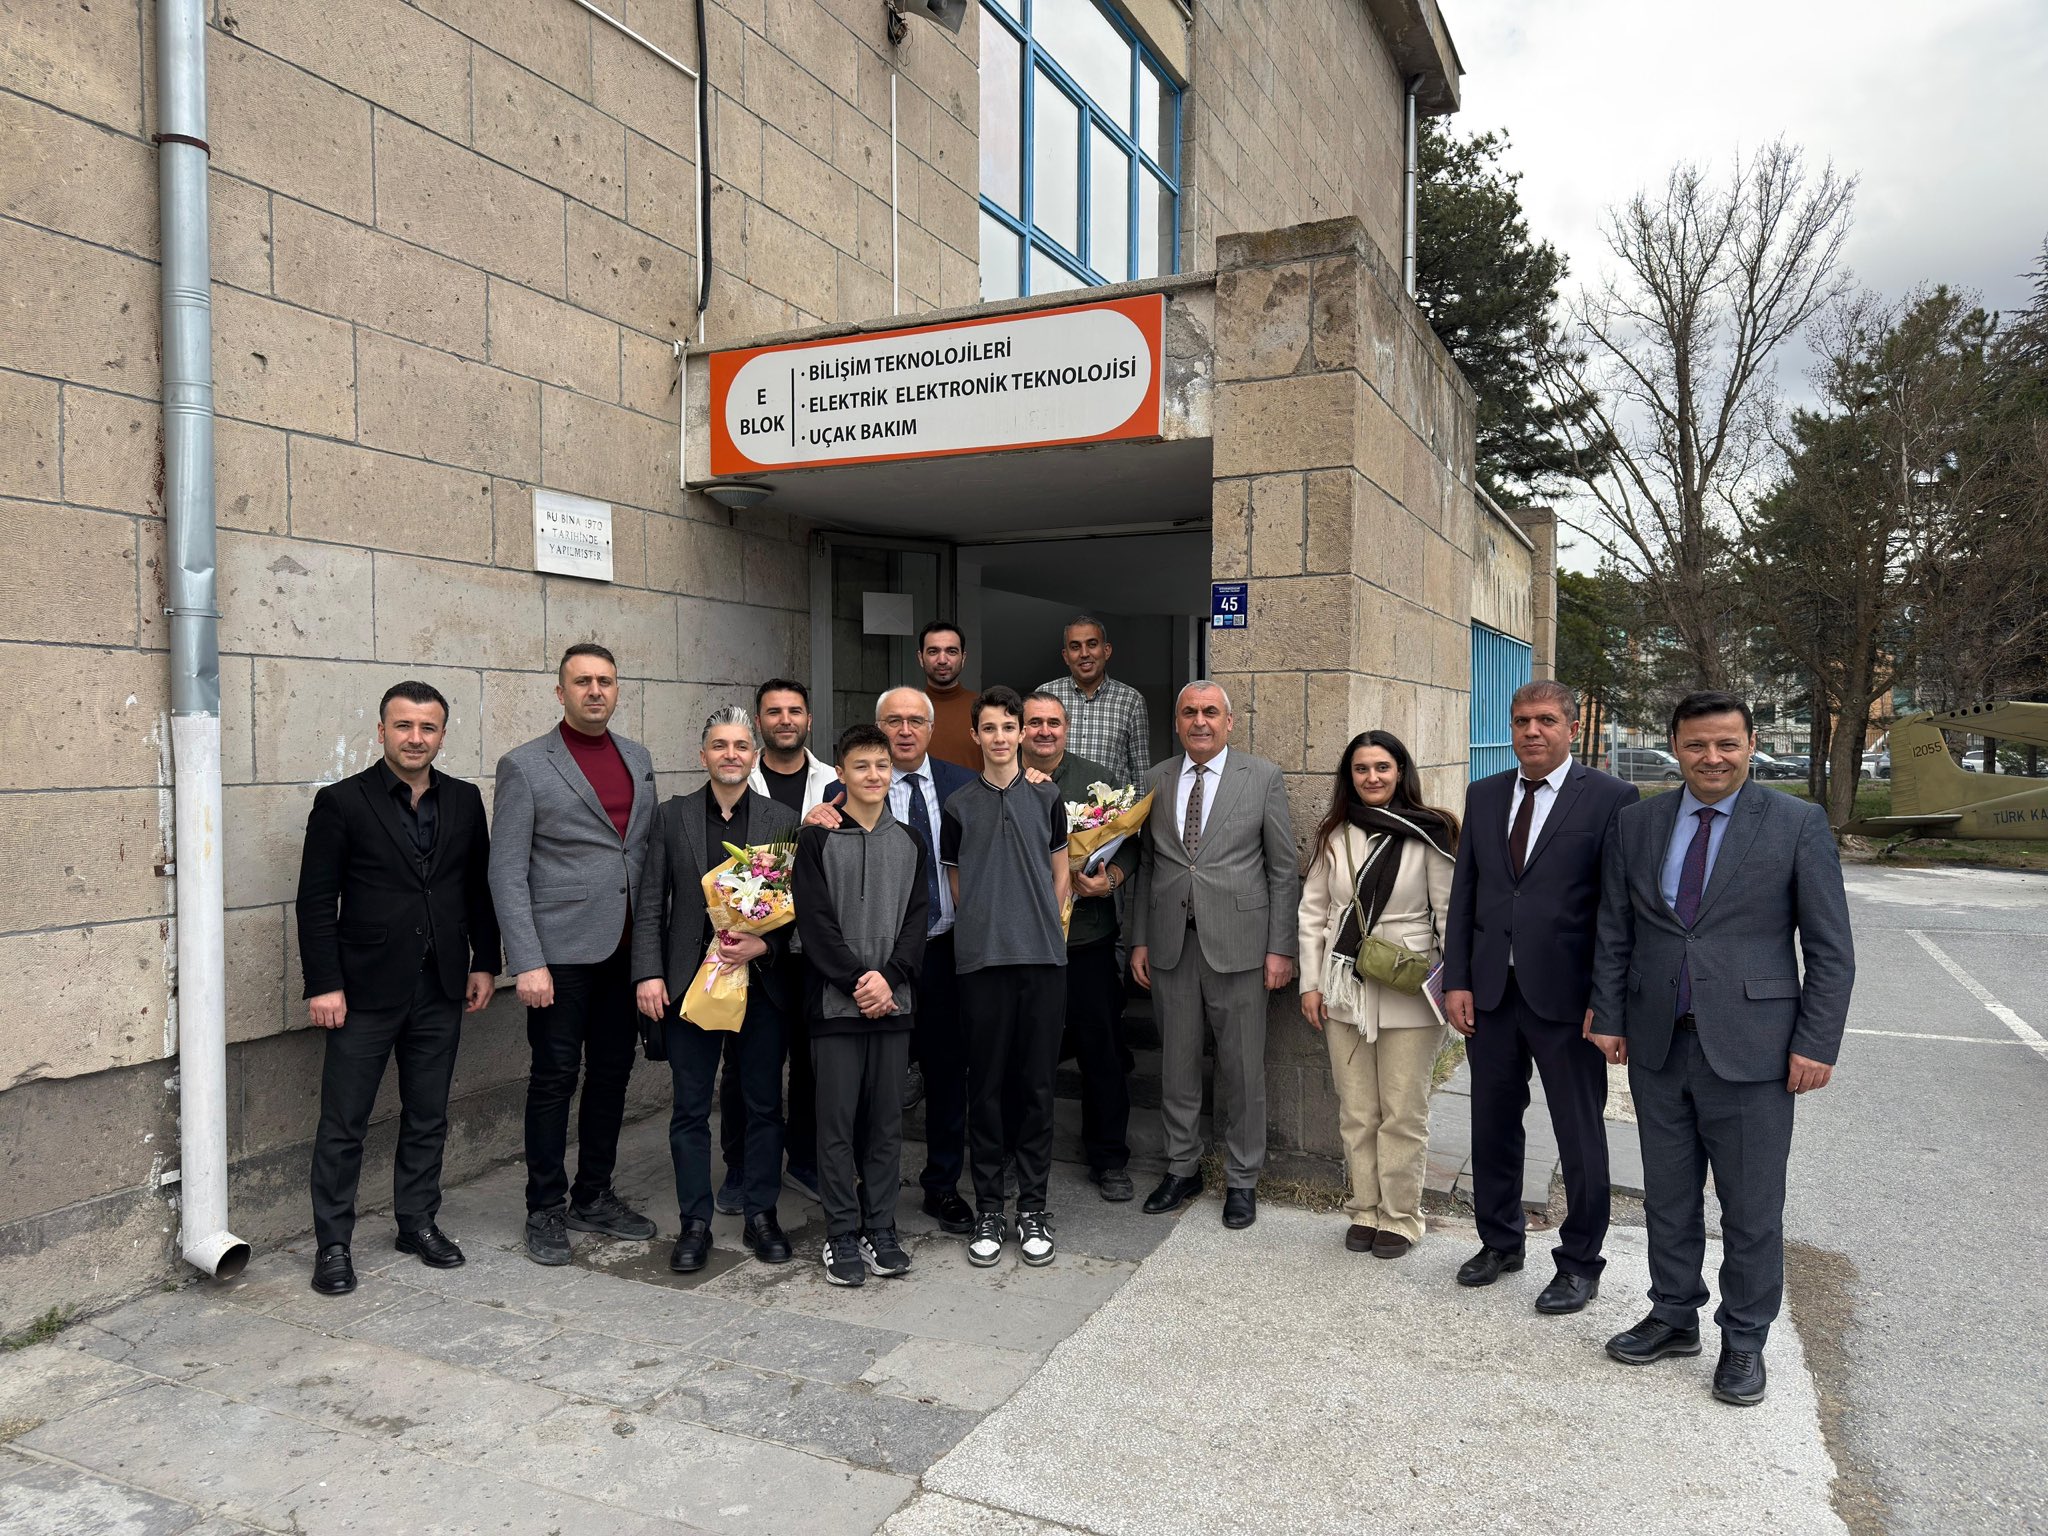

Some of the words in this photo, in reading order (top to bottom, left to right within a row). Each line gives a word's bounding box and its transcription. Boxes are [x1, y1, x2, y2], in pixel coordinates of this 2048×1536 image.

[809, 356, 871, 381] BİLİŞİM
[874, 336, 1011, 373] TEKNOLOJİLERİ
[809, 386, 888, 413] ELEKTRİK
[896, 372, 1008, 404] ELEKTRONİK
[1011, 355, 1136, 391] TEKNOLOJİSİ
[757, 388, 767, 405] E
[740, 415, 785, 435] BLOK
[809, 424, 857, 448] UÇAK
[860, 418, 917, 440] BAKIM
[1220, 596, 1238, 611] 45
[1912, 741, 1942, 758] 12055
